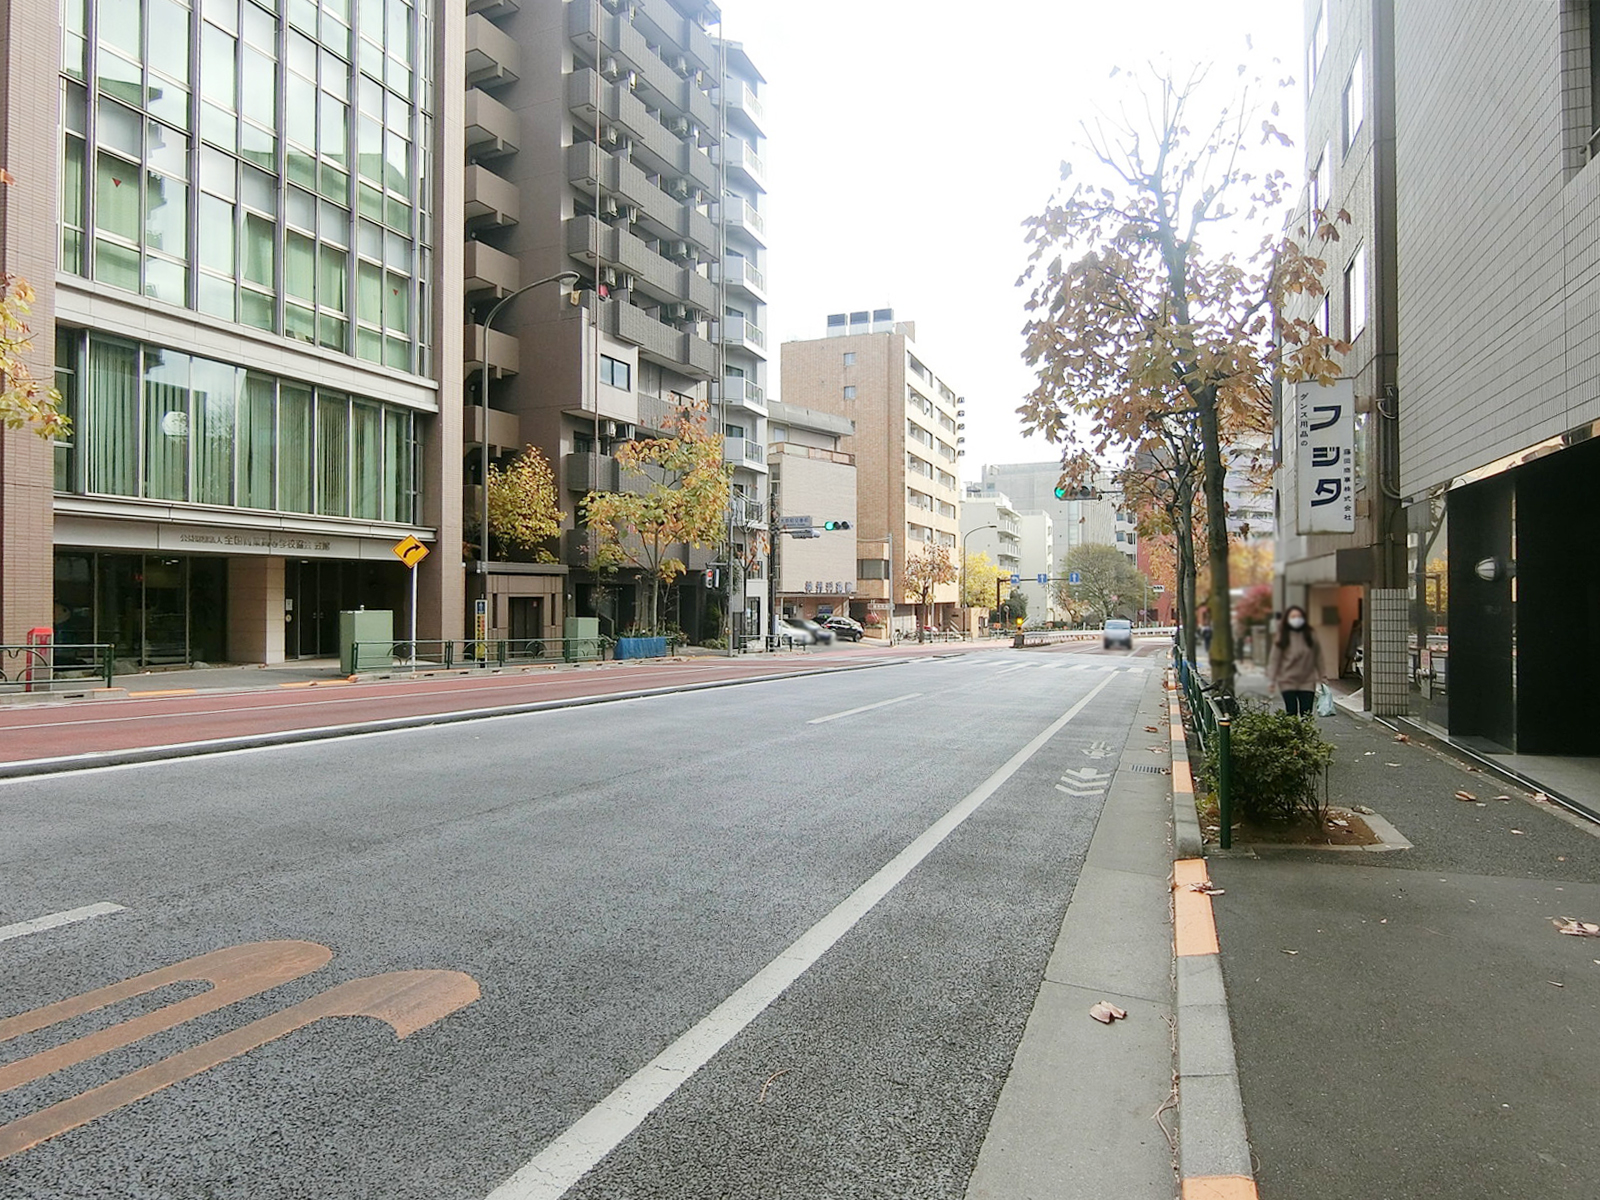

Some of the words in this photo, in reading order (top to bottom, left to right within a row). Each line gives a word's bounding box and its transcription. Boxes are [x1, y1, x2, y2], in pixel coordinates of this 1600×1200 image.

[1299, 392, 1309, 447] ダンス用品の
[1310, 404, 1342, 507] フジタ
